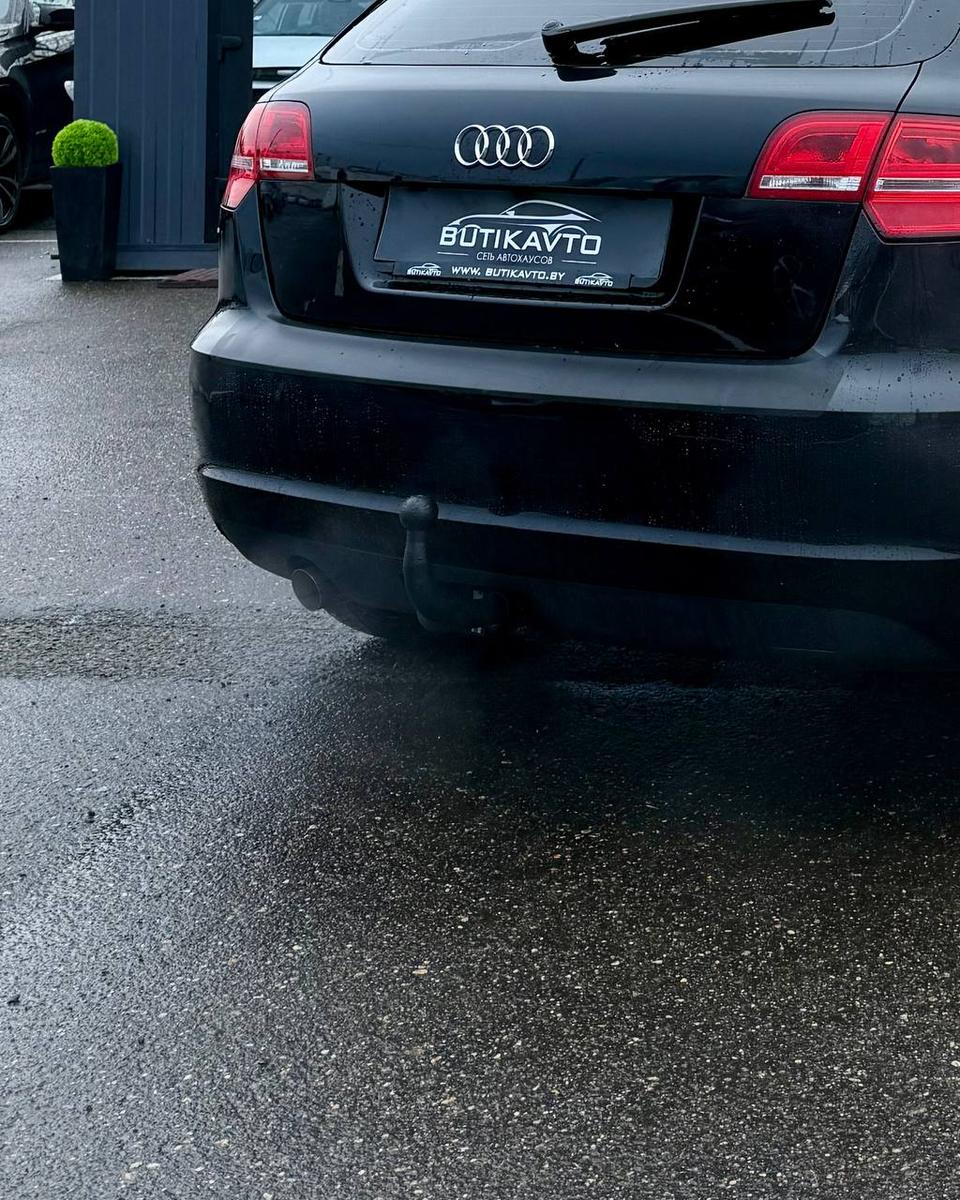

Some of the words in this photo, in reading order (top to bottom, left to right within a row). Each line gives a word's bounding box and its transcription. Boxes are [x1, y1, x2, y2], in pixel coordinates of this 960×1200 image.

[439, 226, 602, 256] BUTIKAVTO
[476, 251, 495, 261] СЕТЬ
[497, 253, 553, 265] АВТОХАУСОВ
[451, 266, 481, 276] WWW.
[485, 267, 566, 281] BUTIKAVTO.BY
